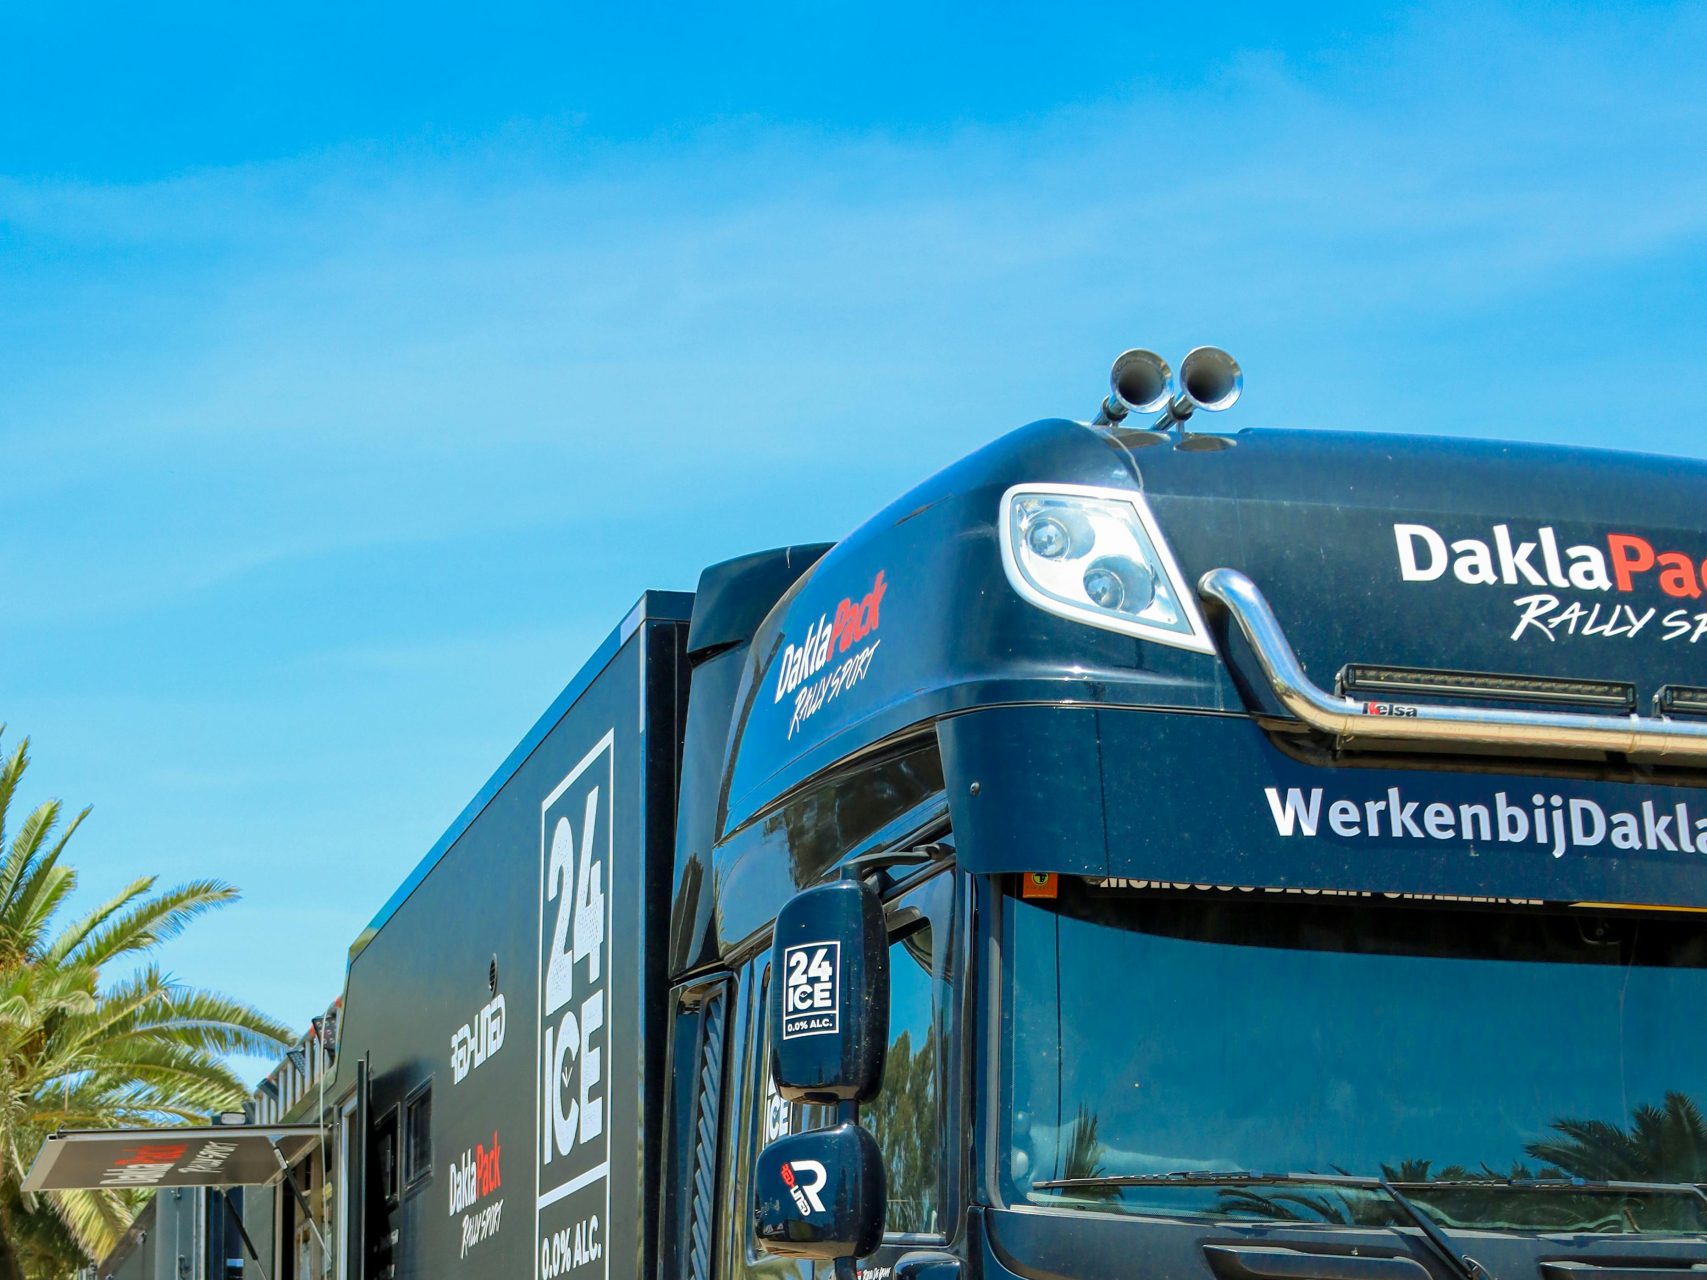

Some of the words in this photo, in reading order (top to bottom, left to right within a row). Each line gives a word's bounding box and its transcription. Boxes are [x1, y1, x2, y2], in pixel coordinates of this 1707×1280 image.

[1394, 523, 1707, 599] DaklaPa
[774, 569, 888, 705] DaklaPack
[1510, 594, 1657, 643] RALLY
[788, 672, 833, 741] RALLY
[827, 639, 881, 704] SPORT
[544, 785, 605, 1017] 24
[787, 981, 833, 1013] ICE
[788, 948, 833, 987] 24
[787, 1020, 808, 1032] 0.0%
[809, 1018, 833, 1029] ALC.
[543, 988, 604, 1166] ICE
[765, 1094, 790, 1144] ICE
[449, 1128, 501, 1217] DaklaPack
[572, 1214, 602, 1270] ALC.
